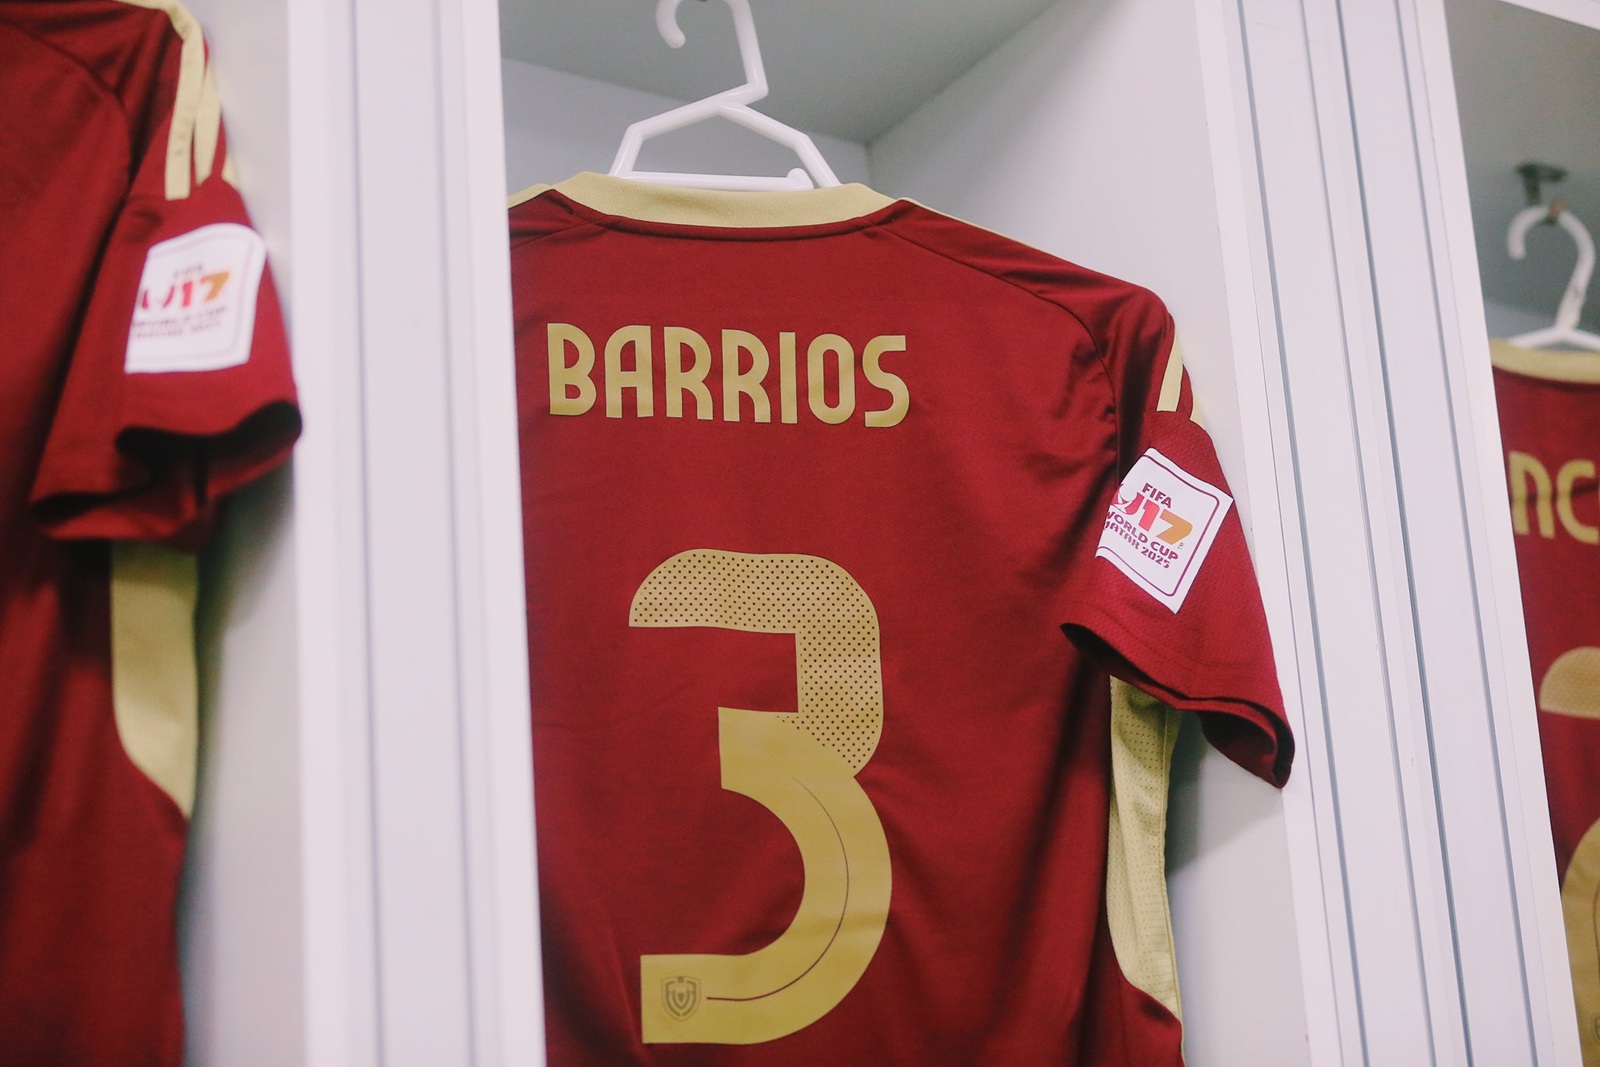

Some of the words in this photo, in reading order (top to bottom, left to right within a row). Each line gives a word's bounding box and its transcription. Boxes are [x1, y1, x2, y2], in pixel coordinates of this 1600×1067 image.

[546, 322, 910, 428] BARRIOS
[1111, 484, 1193, 545] U17
[1141, 482, 1173, 509] FIFA
[1141, 546, 1171, 569] 2025
[1150, 541, 1179, 561] CUP
[628, 547, 892, 1045] 3
